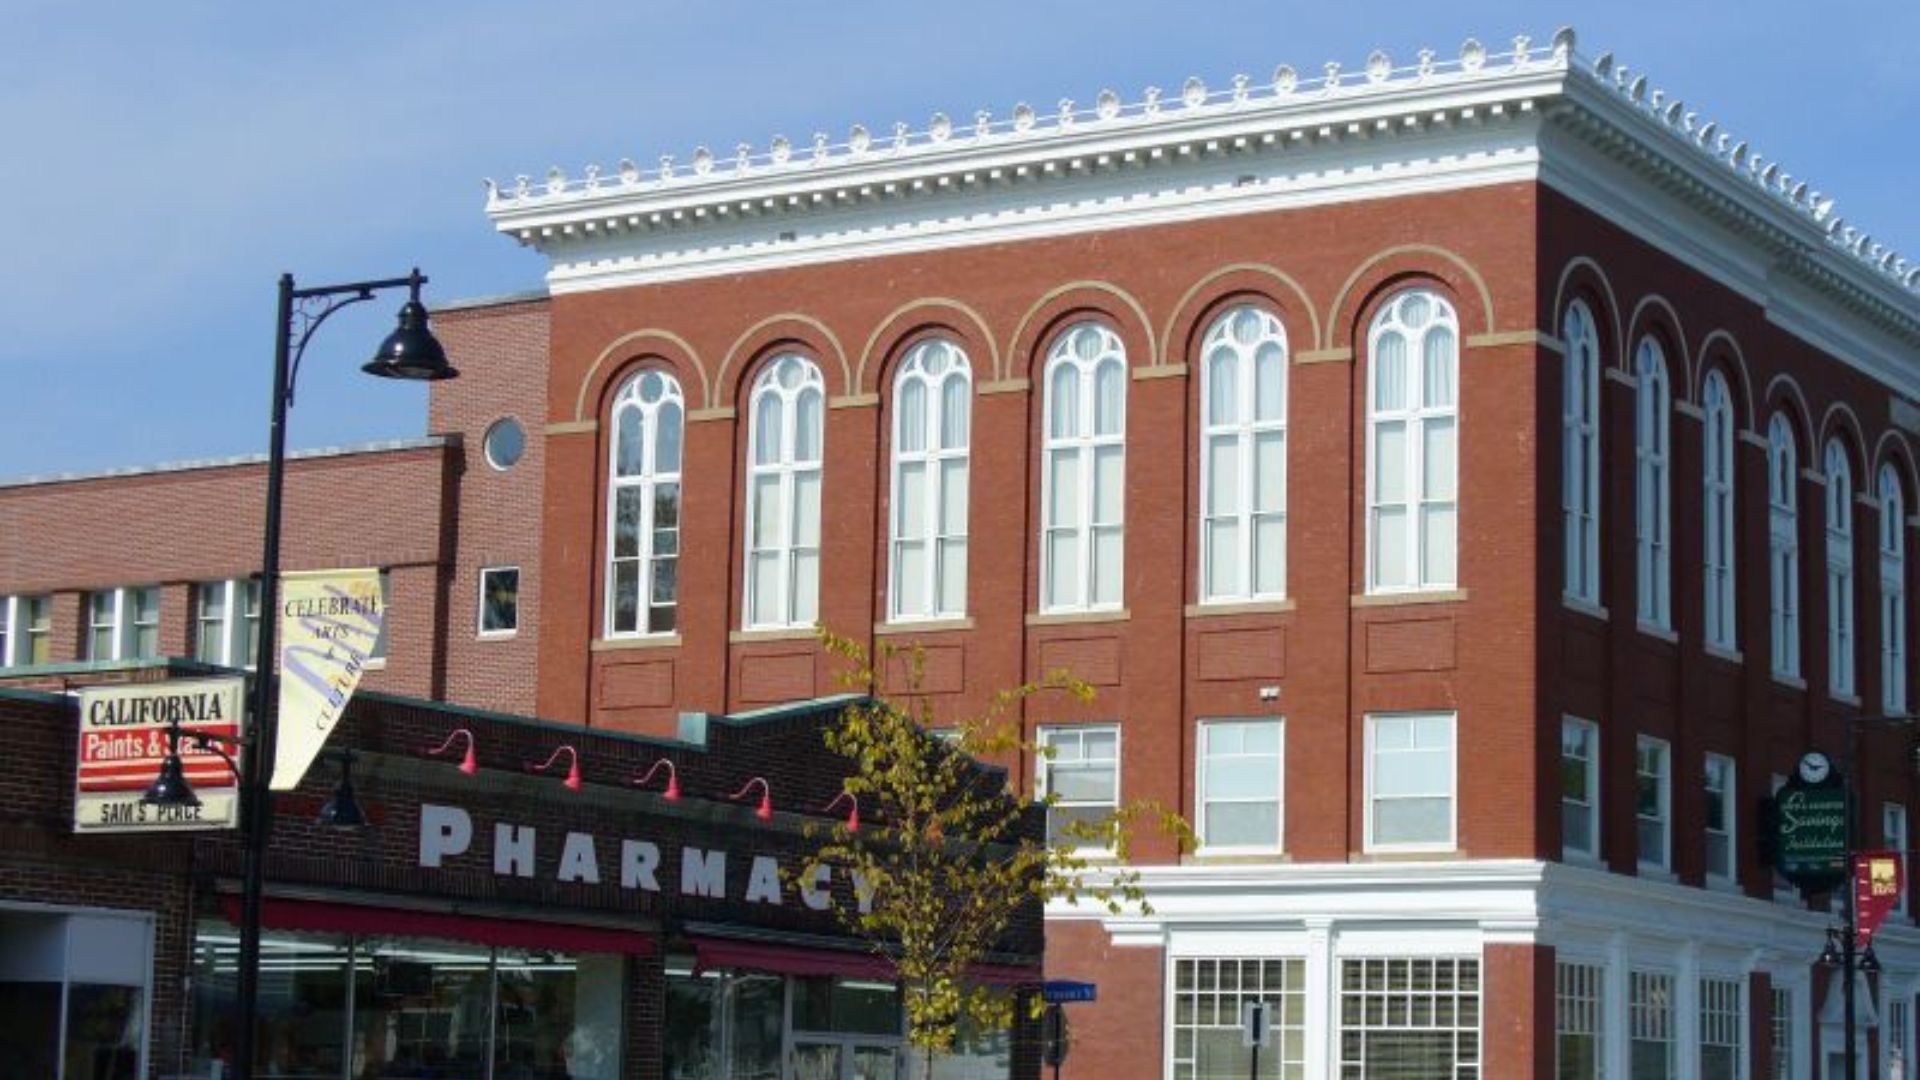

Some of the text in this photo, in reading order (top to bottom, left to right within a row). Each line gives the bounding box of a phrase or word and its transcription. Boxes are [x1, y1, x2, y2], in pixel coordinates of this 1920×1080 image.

[285, 595, 378, 618] CELEBRATE
[312, 623, 350, 640] ARTS
[90, 692, 222, 726] CALIFORNIA
[86, 733, 143, 760] Paints
[148, 731, 160, 757] &
[419, 803, 878, 914] PHARMACY
